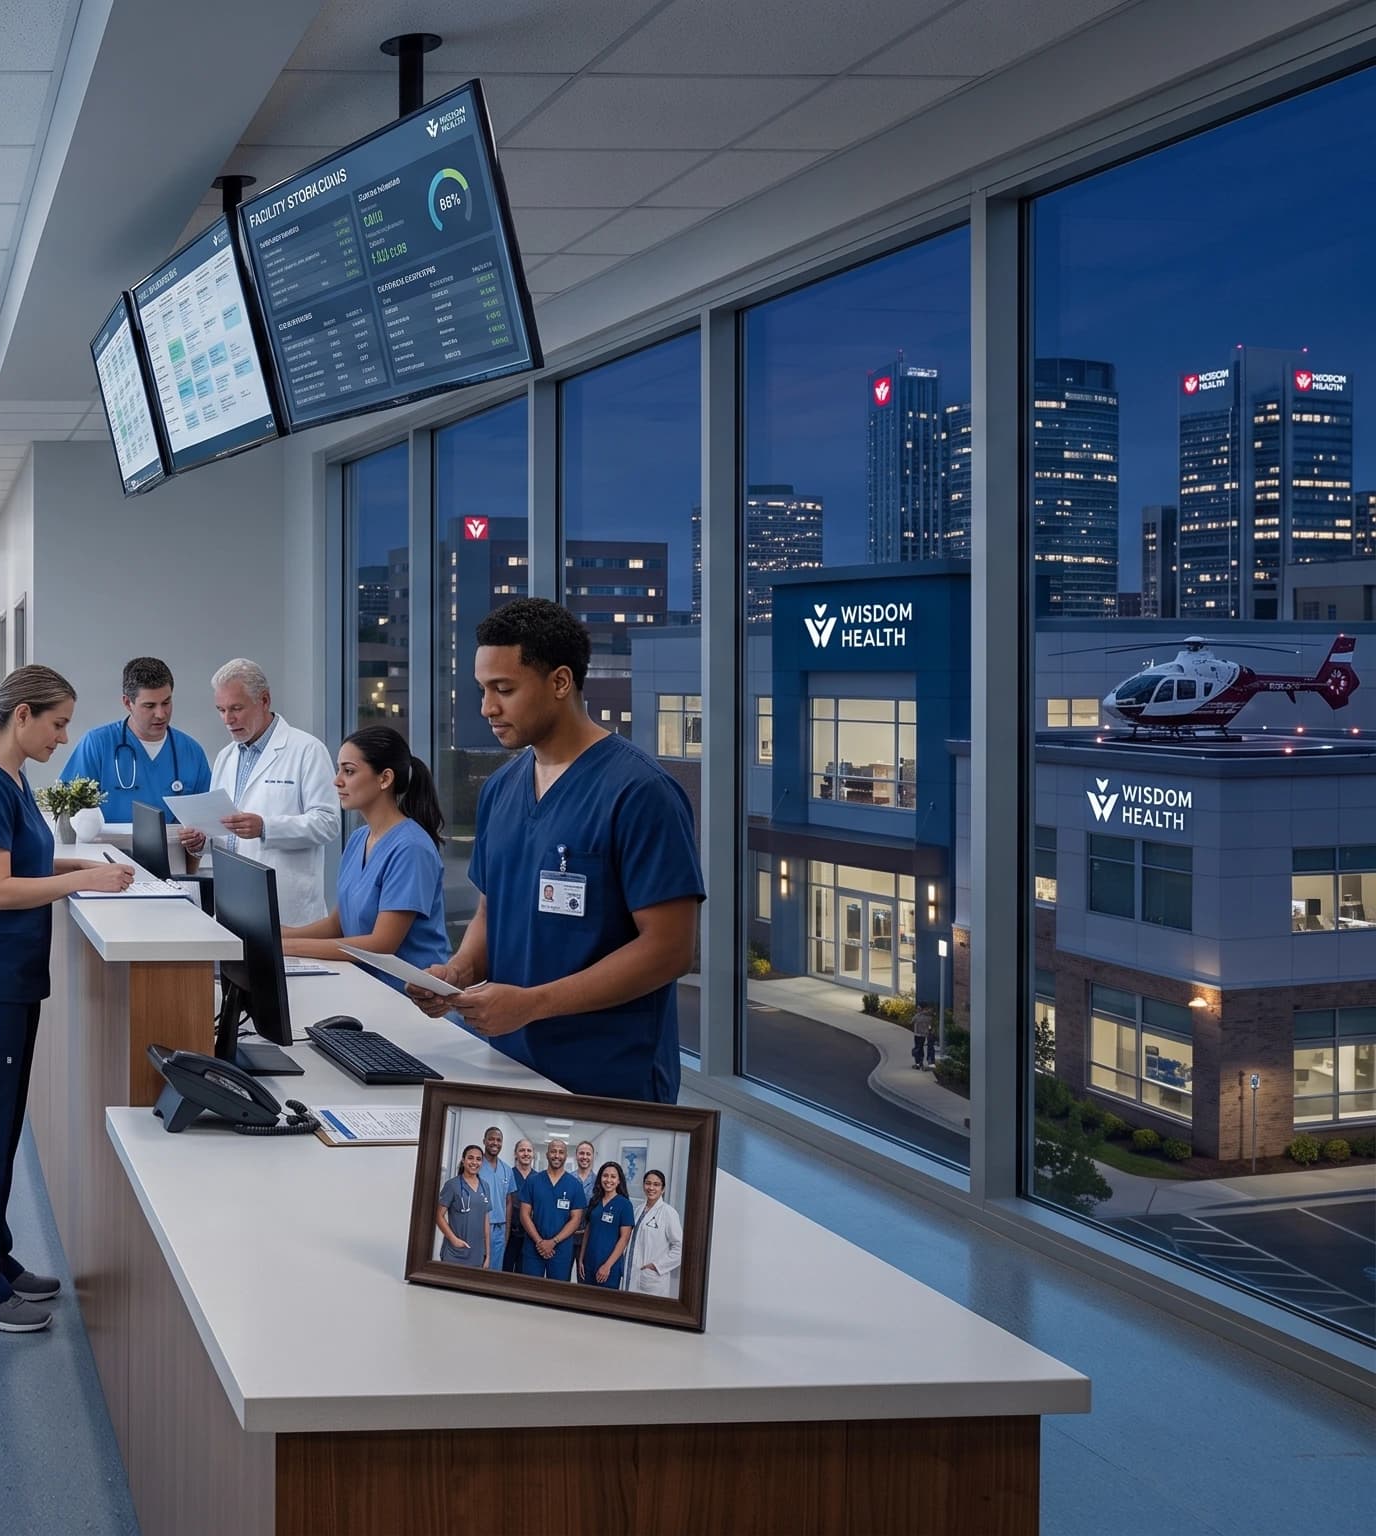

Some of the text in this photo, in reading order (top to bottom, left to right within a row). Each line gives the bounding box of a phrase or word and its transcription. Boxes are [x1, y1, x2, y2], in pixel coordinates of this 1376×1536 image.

[249, 199, 286, 229] FACILITY
[841, 602, 912, 624] WISDOM
[841, 627, 906, 648] HEALTH
[1122, 784, 1192, 809] WISDOM
[1122, 805, 1184, 831] HEALTH
